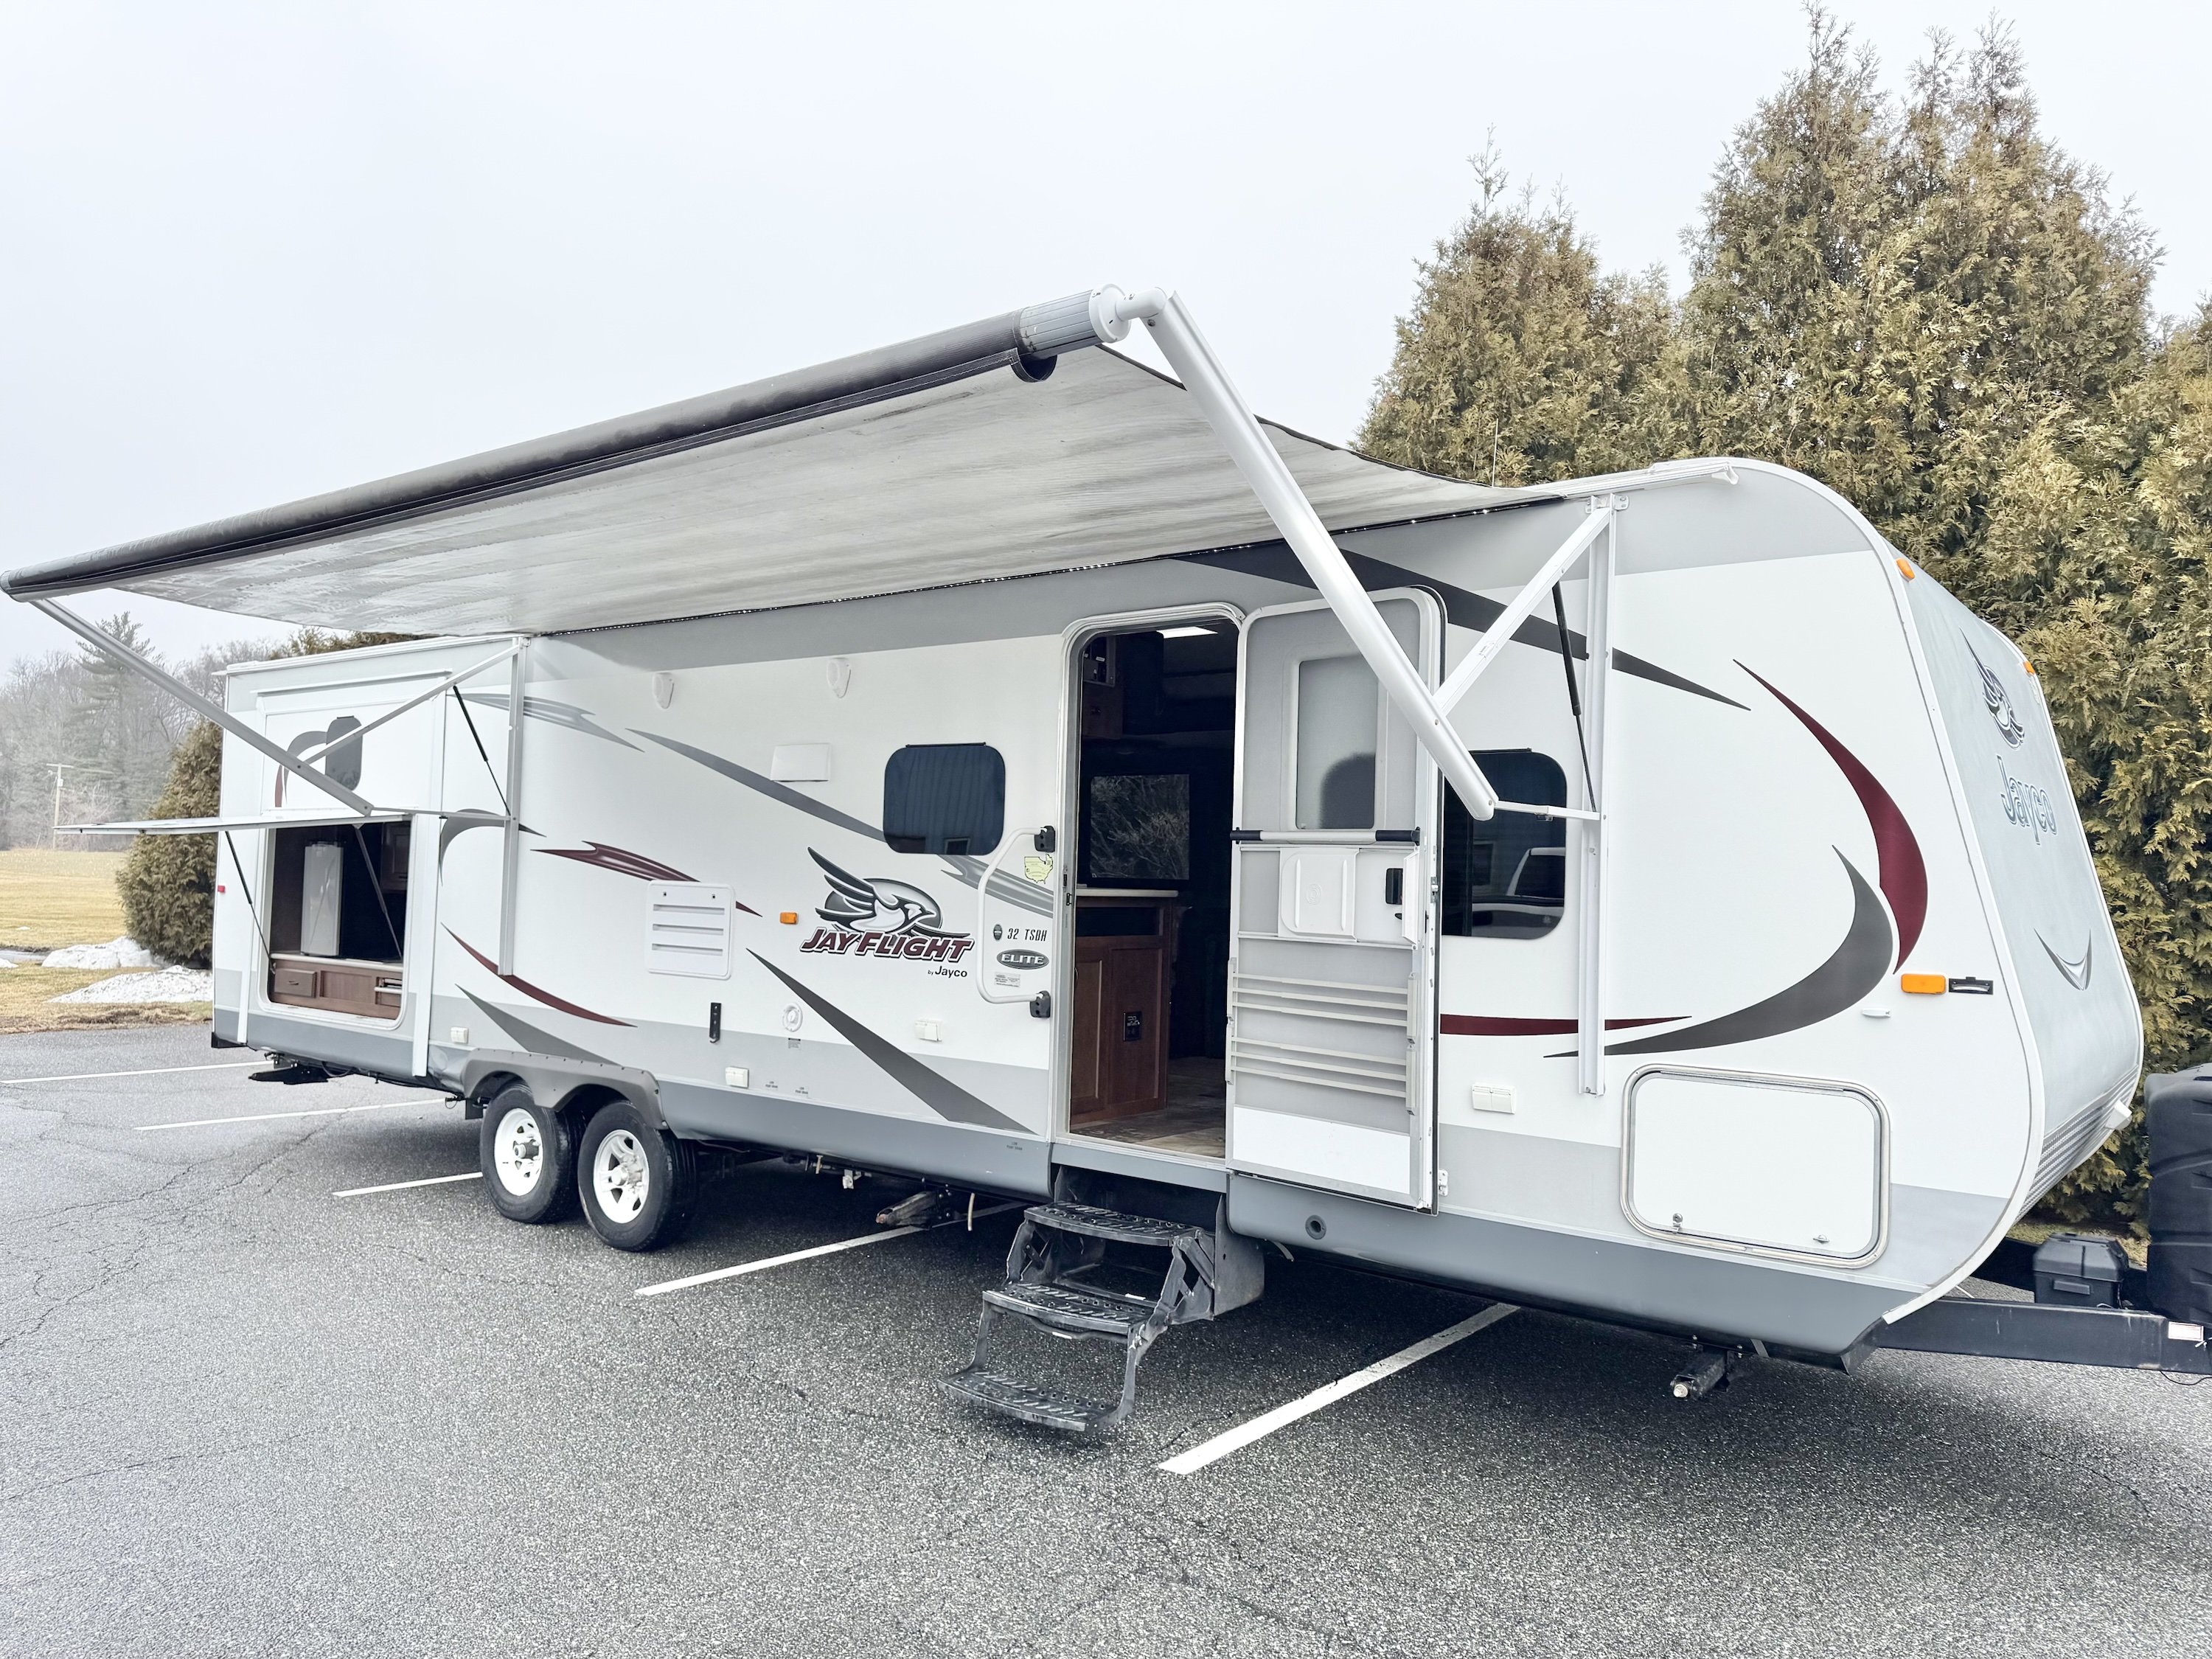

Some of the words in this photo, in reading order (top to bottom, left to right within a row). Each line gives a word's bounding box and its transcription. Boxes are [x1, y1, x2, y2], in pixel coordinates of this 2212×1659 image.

[1996, 754, 2057, 846] Jayco
[1007, 928, 1019, 939] 32
[801, 928, 858, 953] JAY
[855, 931, 974, 961] FLIGHT
[1001, 953, 1045, 965] ELITE
[935, 965, 967, 978] Jayco
